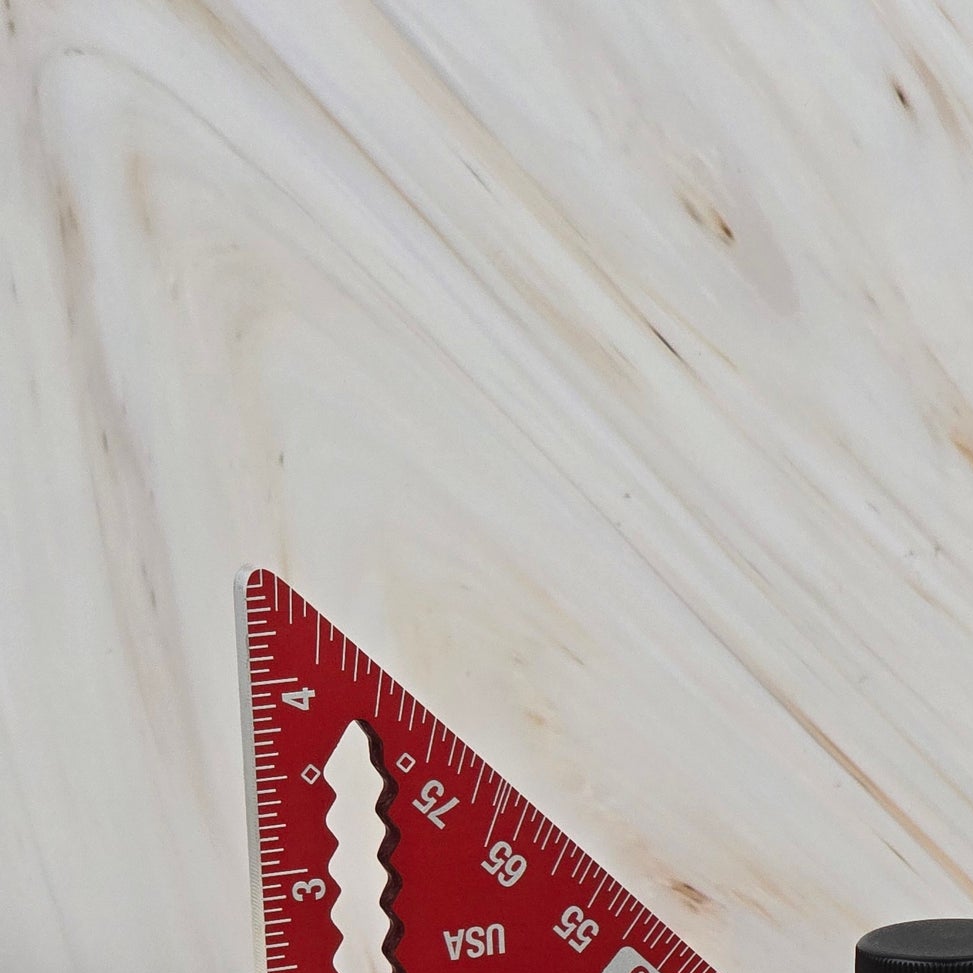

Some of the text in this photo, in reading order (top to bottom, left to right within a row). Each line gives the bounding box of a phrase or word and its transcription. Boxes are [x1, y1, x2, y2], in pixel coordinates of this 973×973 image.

[282, 687, 315, 710] 4
[412, 780, 460, 829] 75
[481, 841, 527, 887] 65
[292, 879, 326, 901] 3
[443, 924, 505, 960] USA
[553, 906, 599, 953] 55
